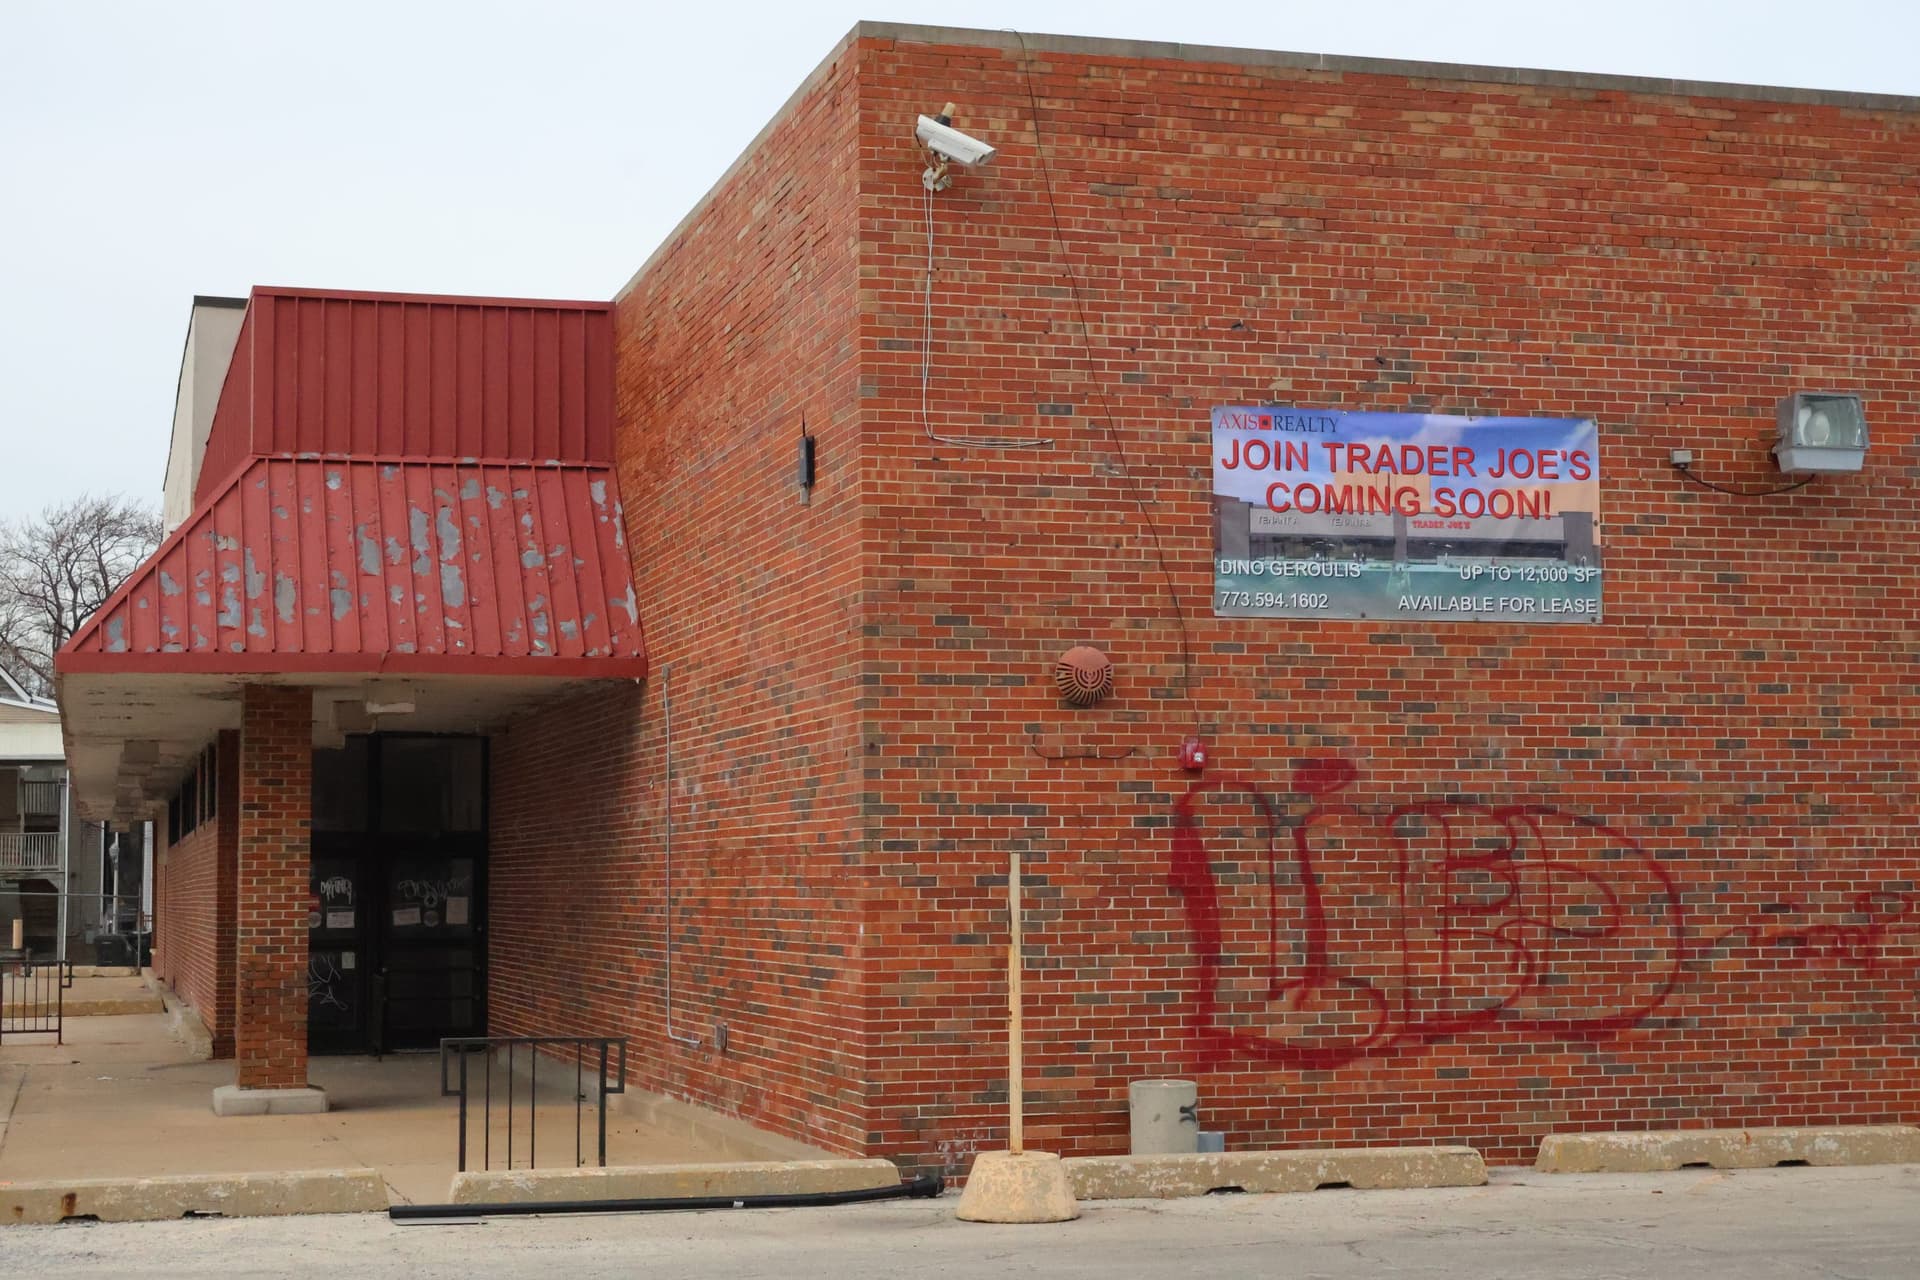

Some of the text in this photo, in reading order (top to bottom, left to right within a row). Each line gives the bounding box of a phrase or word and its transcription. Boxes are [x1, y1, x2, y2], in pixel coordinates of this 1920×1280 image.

[1218, 414, 1339, 433] AXIS REALTY
[1221, 439, 1591, 480] JOIN TRADER JOE'S
[1265, 482, 1551, 520] COMING SOON!
[1220, 559, 1362, 578] DINO GEROULIS
[1459, 565, 1598, 584] UP TO 12,000 SF
[1220, 591, 1329, 609] 773.594.1602
[1398, 595, 1598, 614] AVAILABLE FOR LEASE
